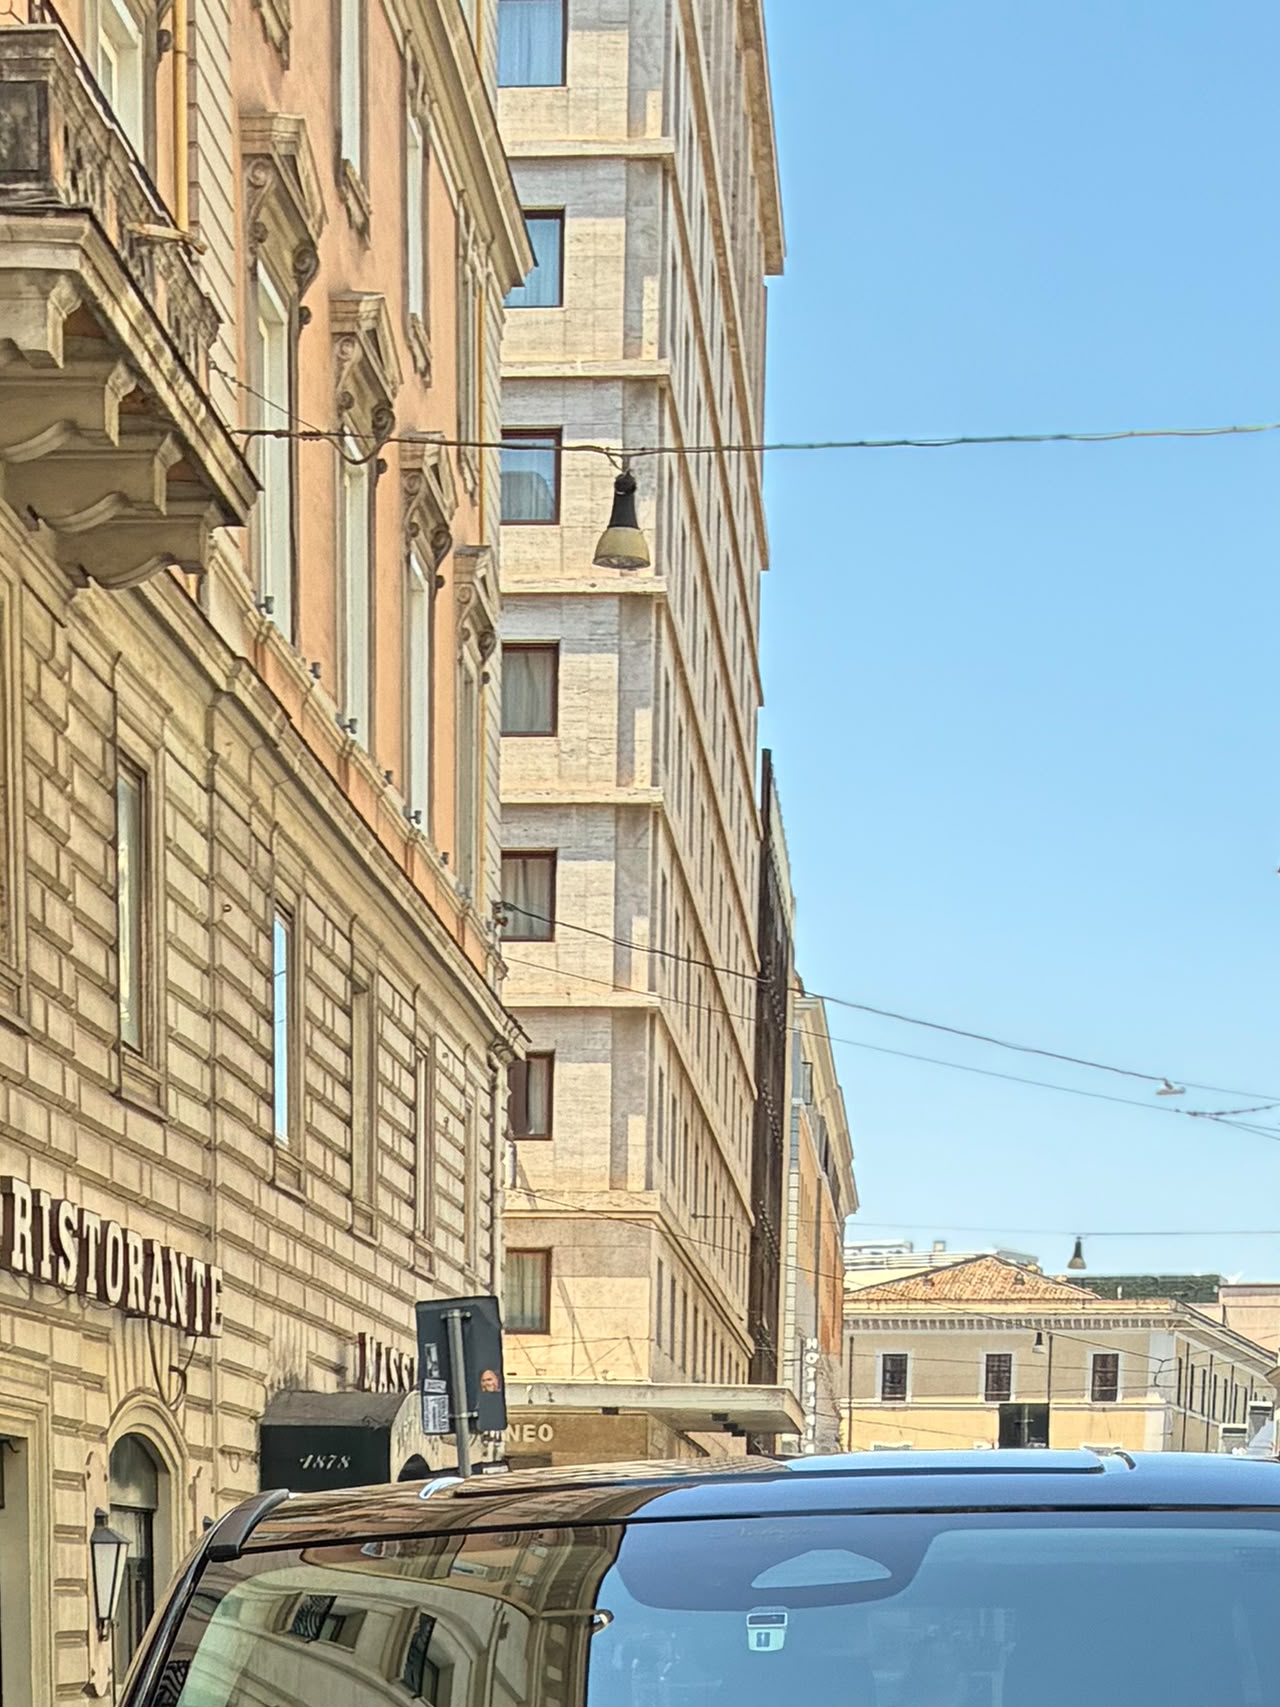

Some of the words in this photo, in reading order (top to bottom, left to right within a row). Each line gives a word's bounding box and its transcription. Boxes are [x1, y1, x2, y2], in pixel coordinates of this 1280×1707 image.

[0, 1175, 222, 1338] RISTORANTE
[358, 1332, 416, 1393] MASS
[503, 1423, 554, 1442] NEO
[299, 1454, 351, 1470] 1878
